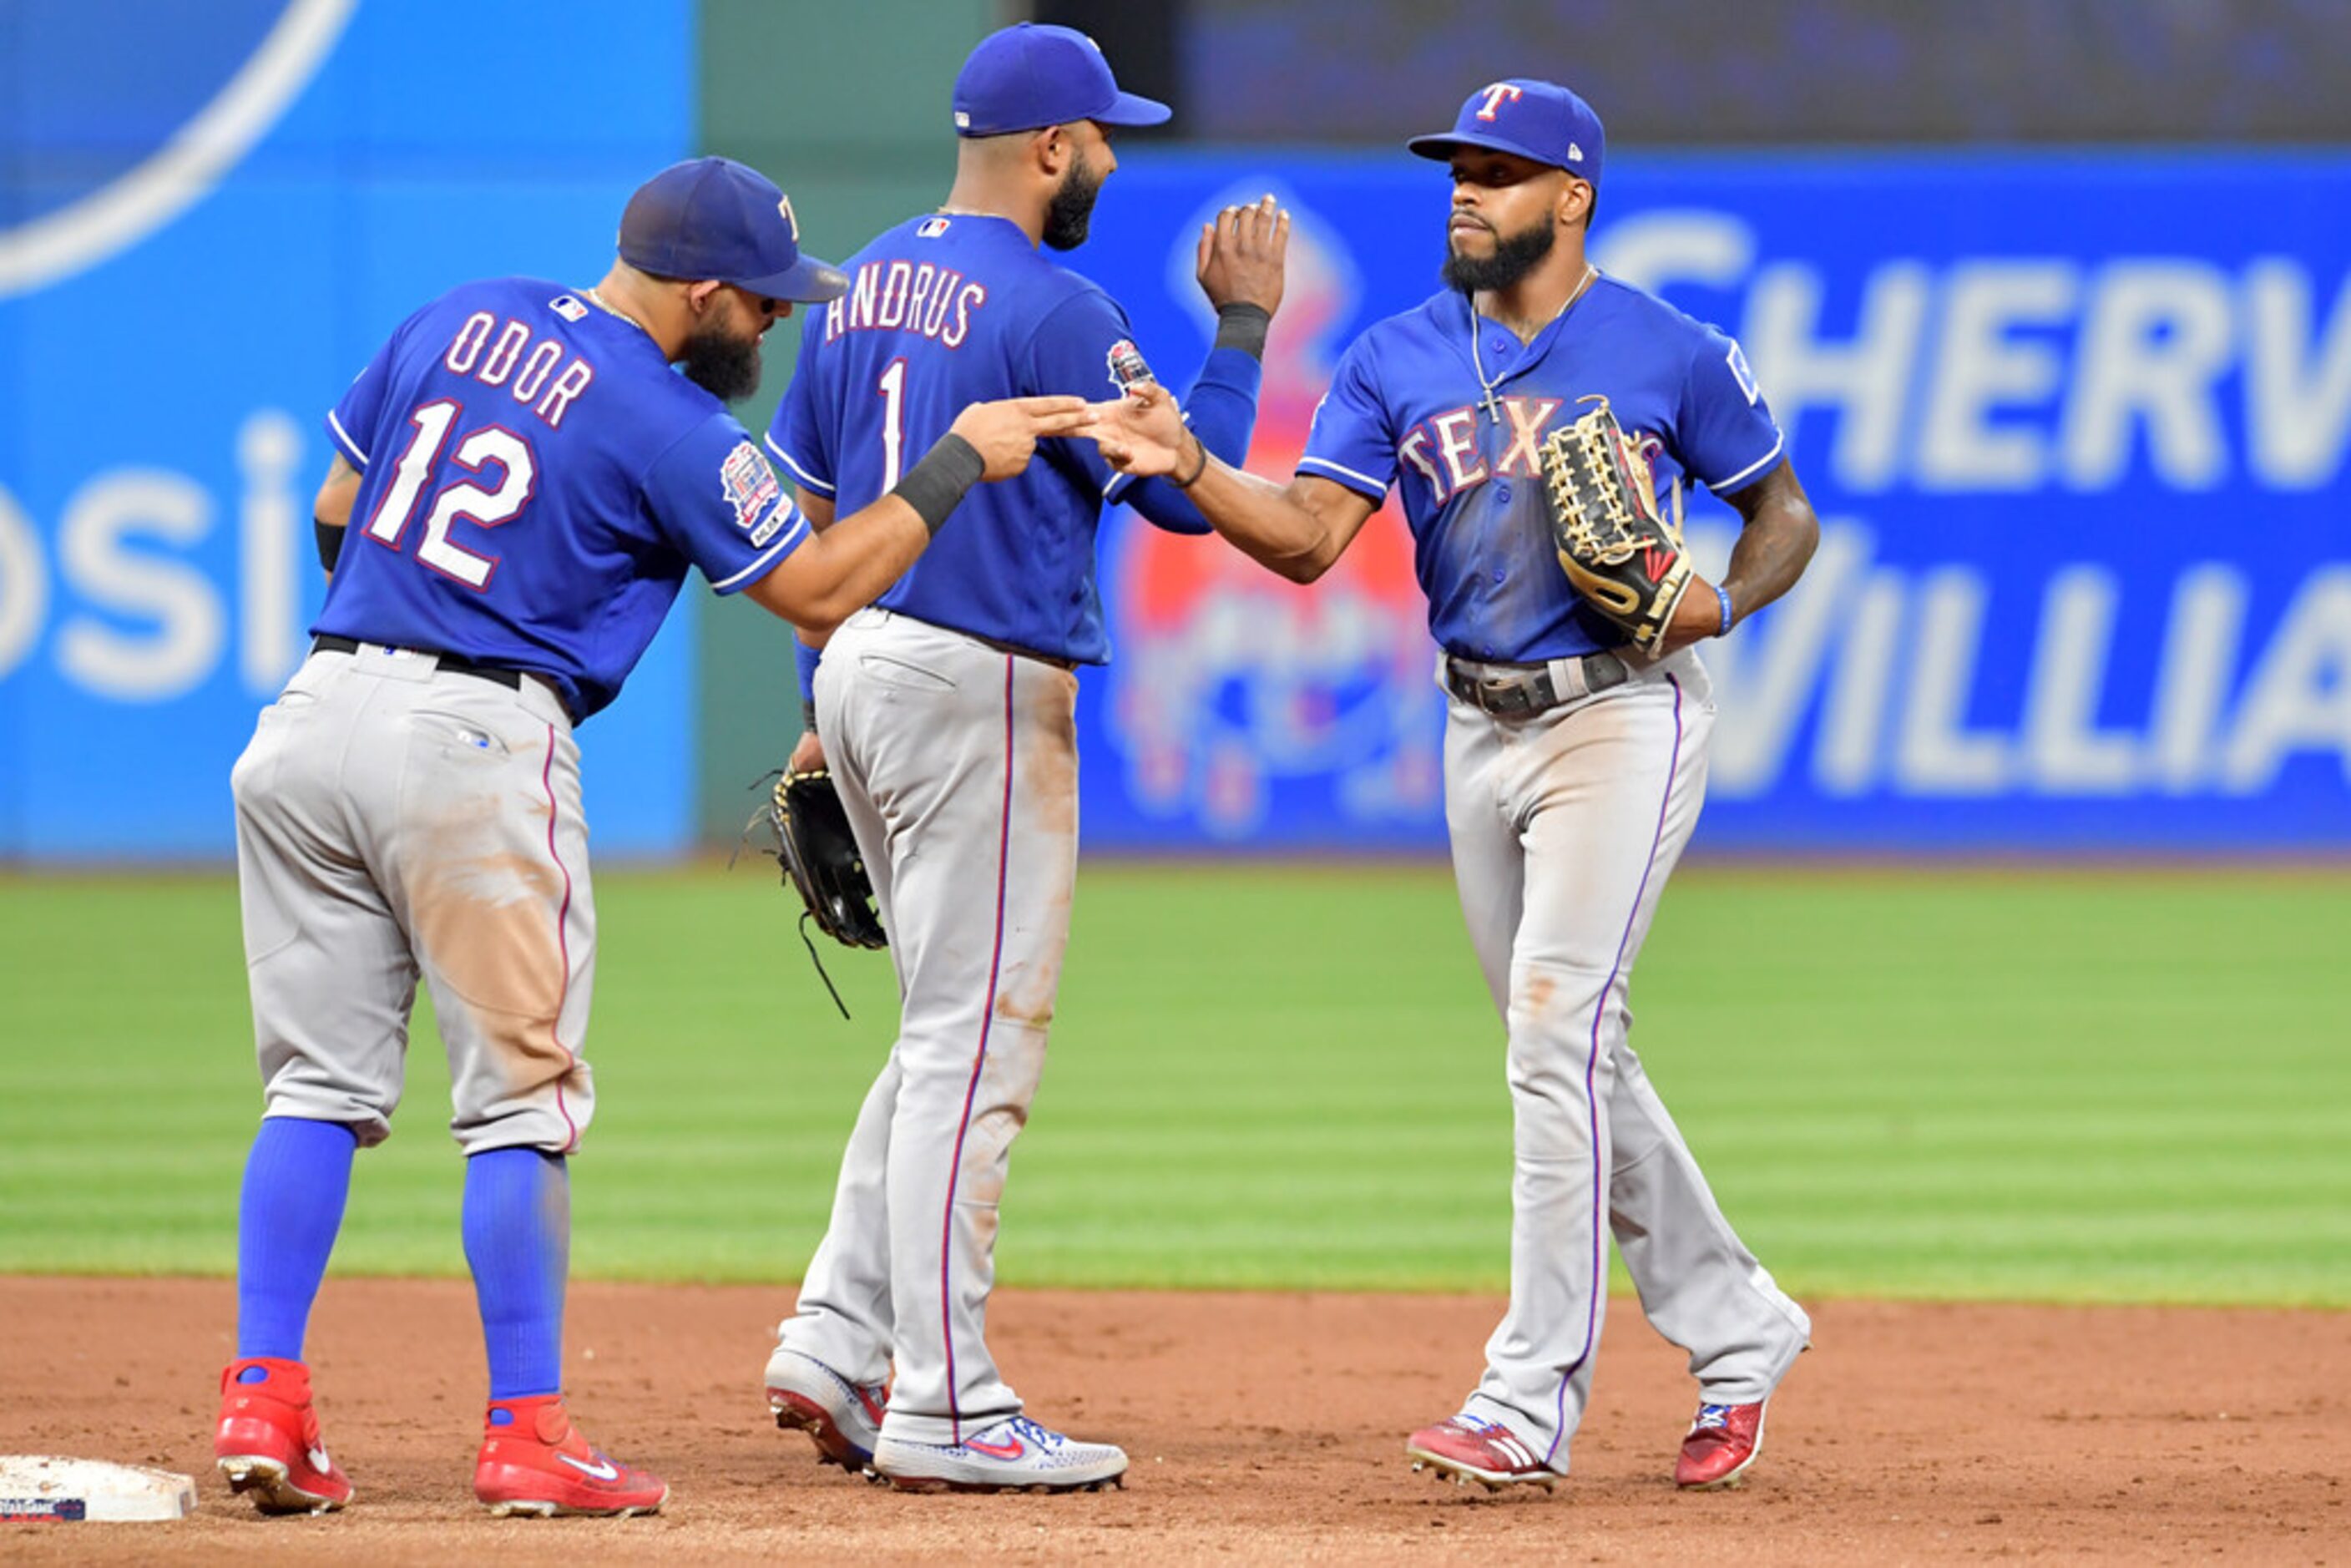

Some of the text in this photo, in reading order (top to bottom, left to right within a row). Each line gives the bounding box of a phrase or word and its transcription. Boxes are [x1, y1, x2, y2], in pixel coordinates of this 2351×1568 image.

[1476, 82, 1523, 122] T
[825, 260, 988, 349] ANDRUS
[444, 310, 595, 430] ODOR
[878, 356, 908, 498] 1
[361, 396, 537, 593] 12
[1396, 396, 1665, 509] TEX
